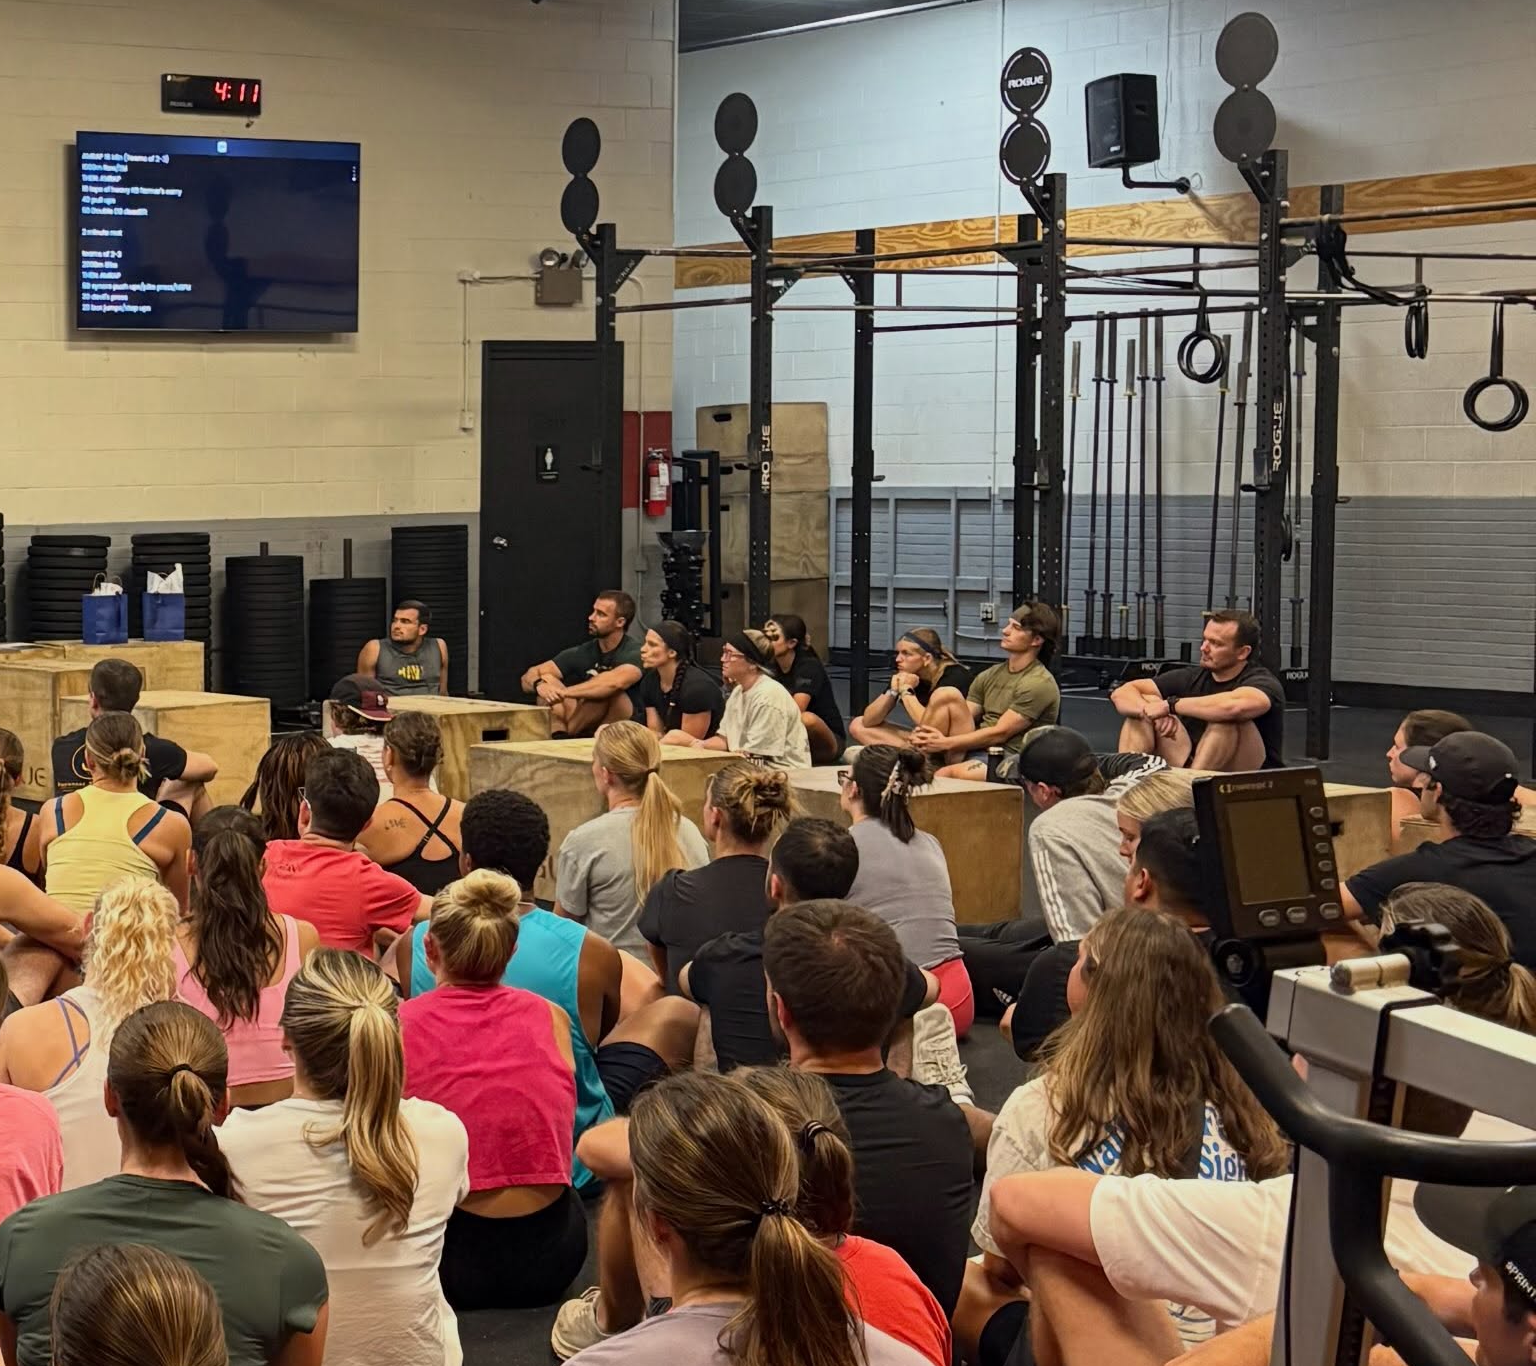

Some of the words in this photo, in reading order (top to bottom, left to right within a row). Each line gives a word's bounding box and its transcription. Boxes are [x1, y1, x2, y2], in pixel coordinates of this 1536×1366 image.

[1008, 75, 1045, 89] ROGUE
[215, 81, 260, 104] 4:11
[1272, 401, 1283, 472] ROGUE
[1141, 662, 1162, 671] ROG
